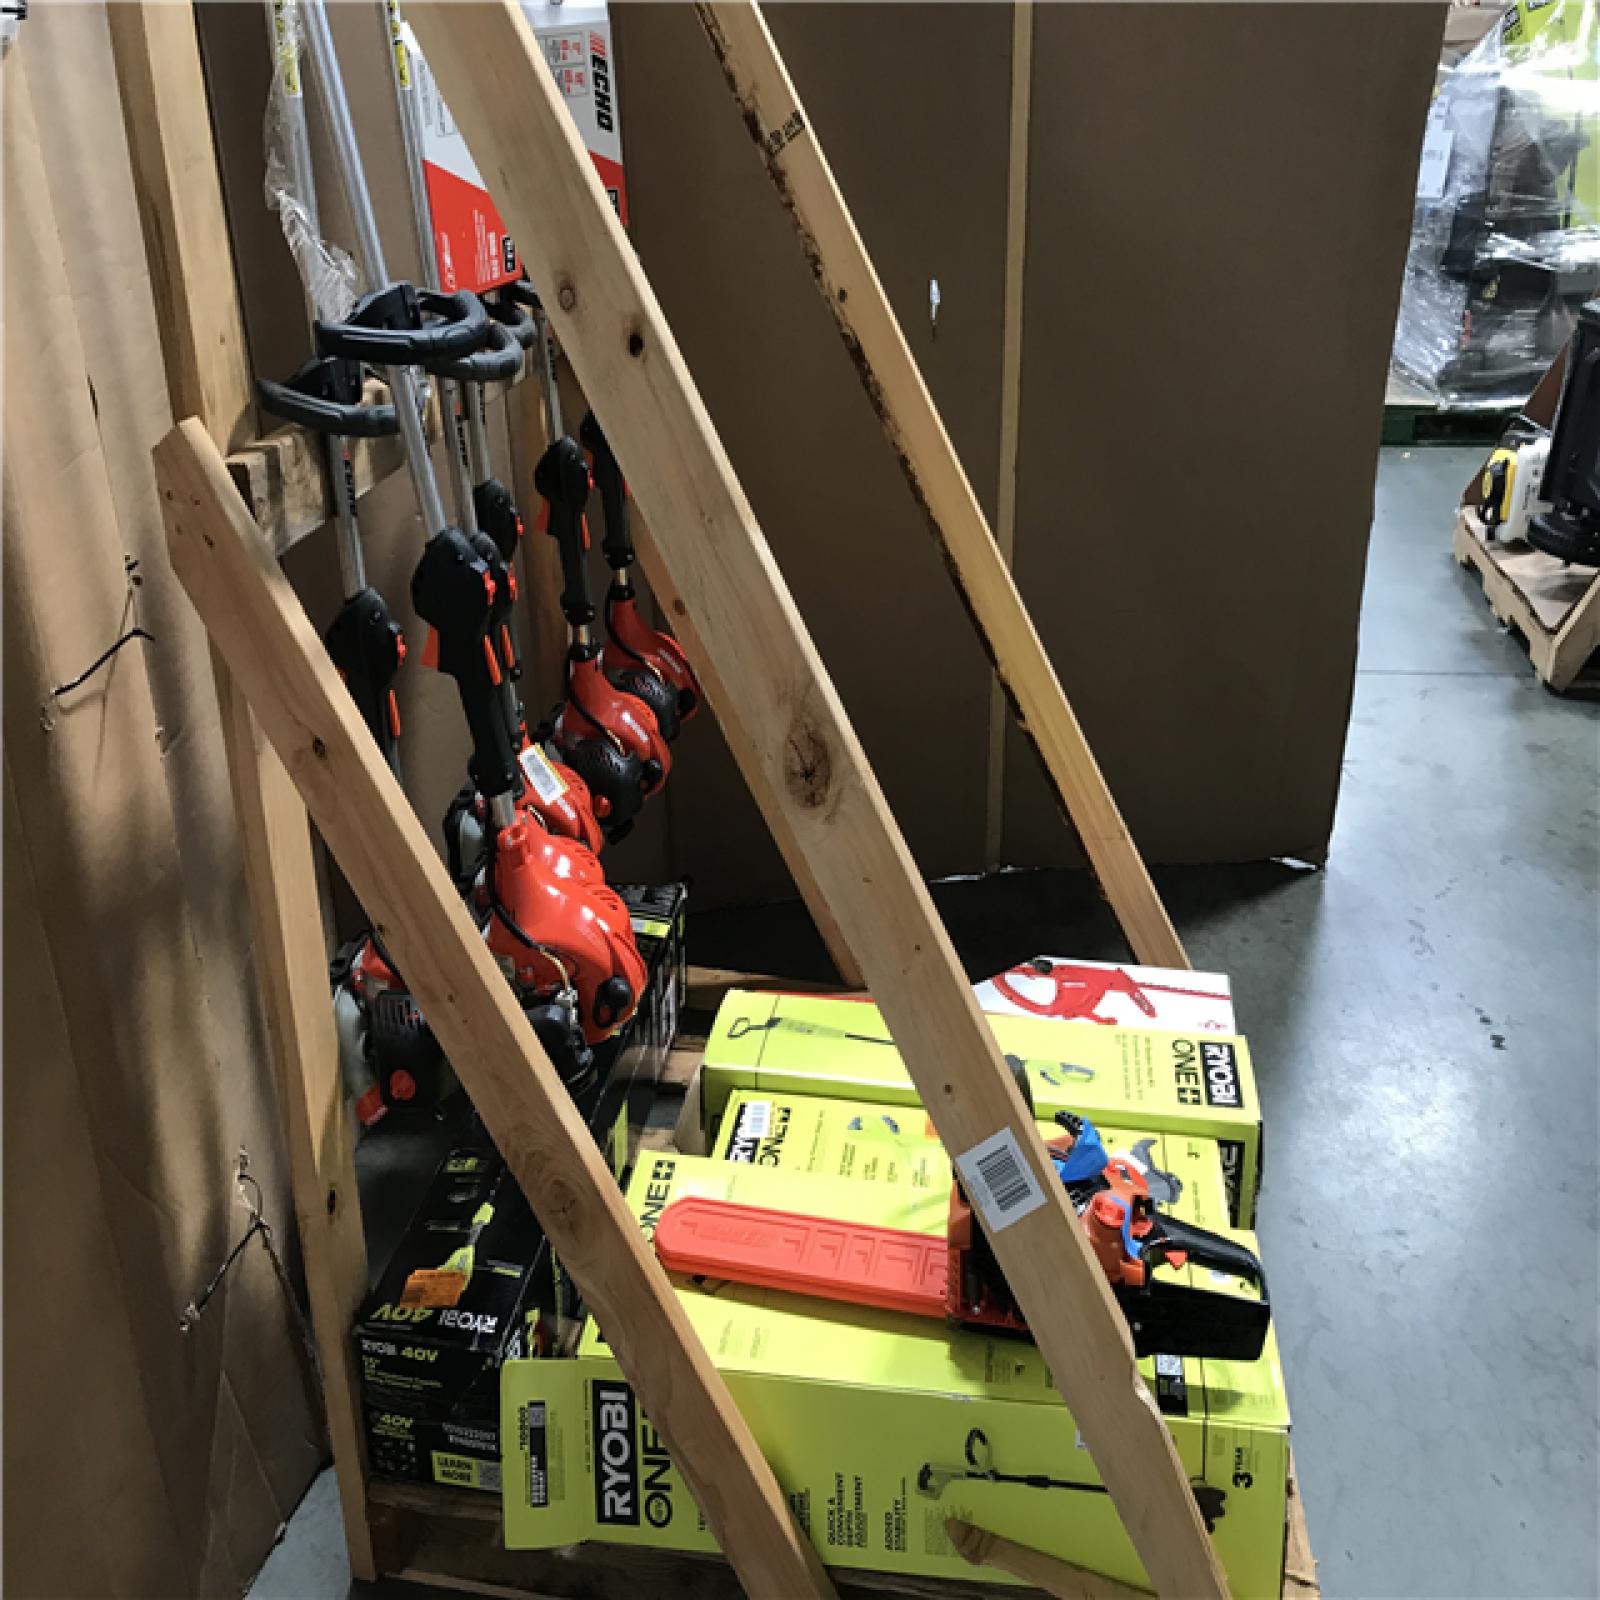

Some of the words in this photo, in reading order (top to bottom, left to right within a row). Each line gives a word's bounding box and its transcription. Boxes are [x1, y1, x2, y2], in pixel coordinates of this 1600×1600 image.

[591, 54, 613, 133] ECHO
[1204, 1044, 1237, 1104] RYOBI
[400, 1347, 439, 1363] 40V
[600, 1389, 633, 1518] RYOBI
[1232, 1471, 1253, 1489] 3
[827, 1509, 836, 1546] QUICK
[884, 1512, 893, 1550] ADDED
